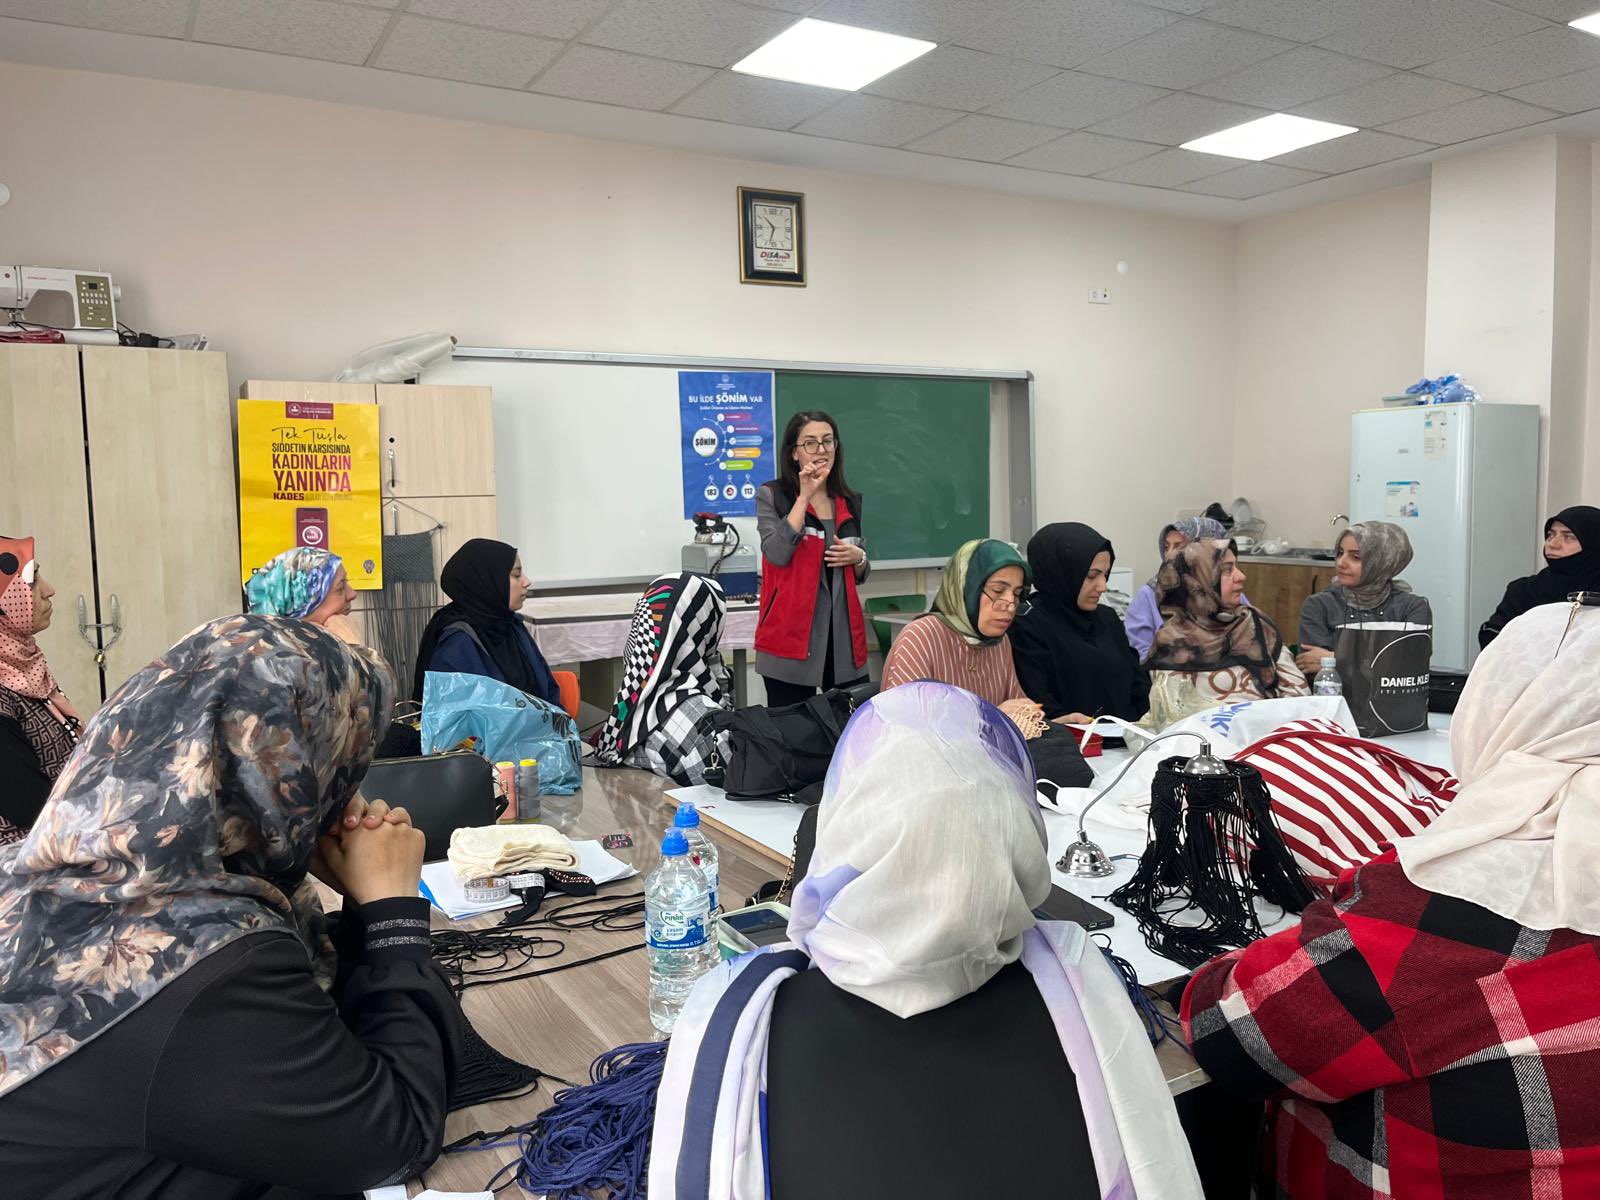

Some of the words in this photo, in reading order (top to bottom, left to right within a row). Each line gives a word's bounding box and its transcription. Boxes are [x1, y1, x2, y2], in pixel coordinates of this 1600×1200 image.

[715, 392, 748, 405] ŞÖNİM
[271, 427, 302, 443] Tek
[272, 454, 351, 471] KADINLARIN
[274, 470, 351, 492] YANINDA
[273, 492, 304, 501] KADES
[1381, 676, 1416, 687] DANIEL
